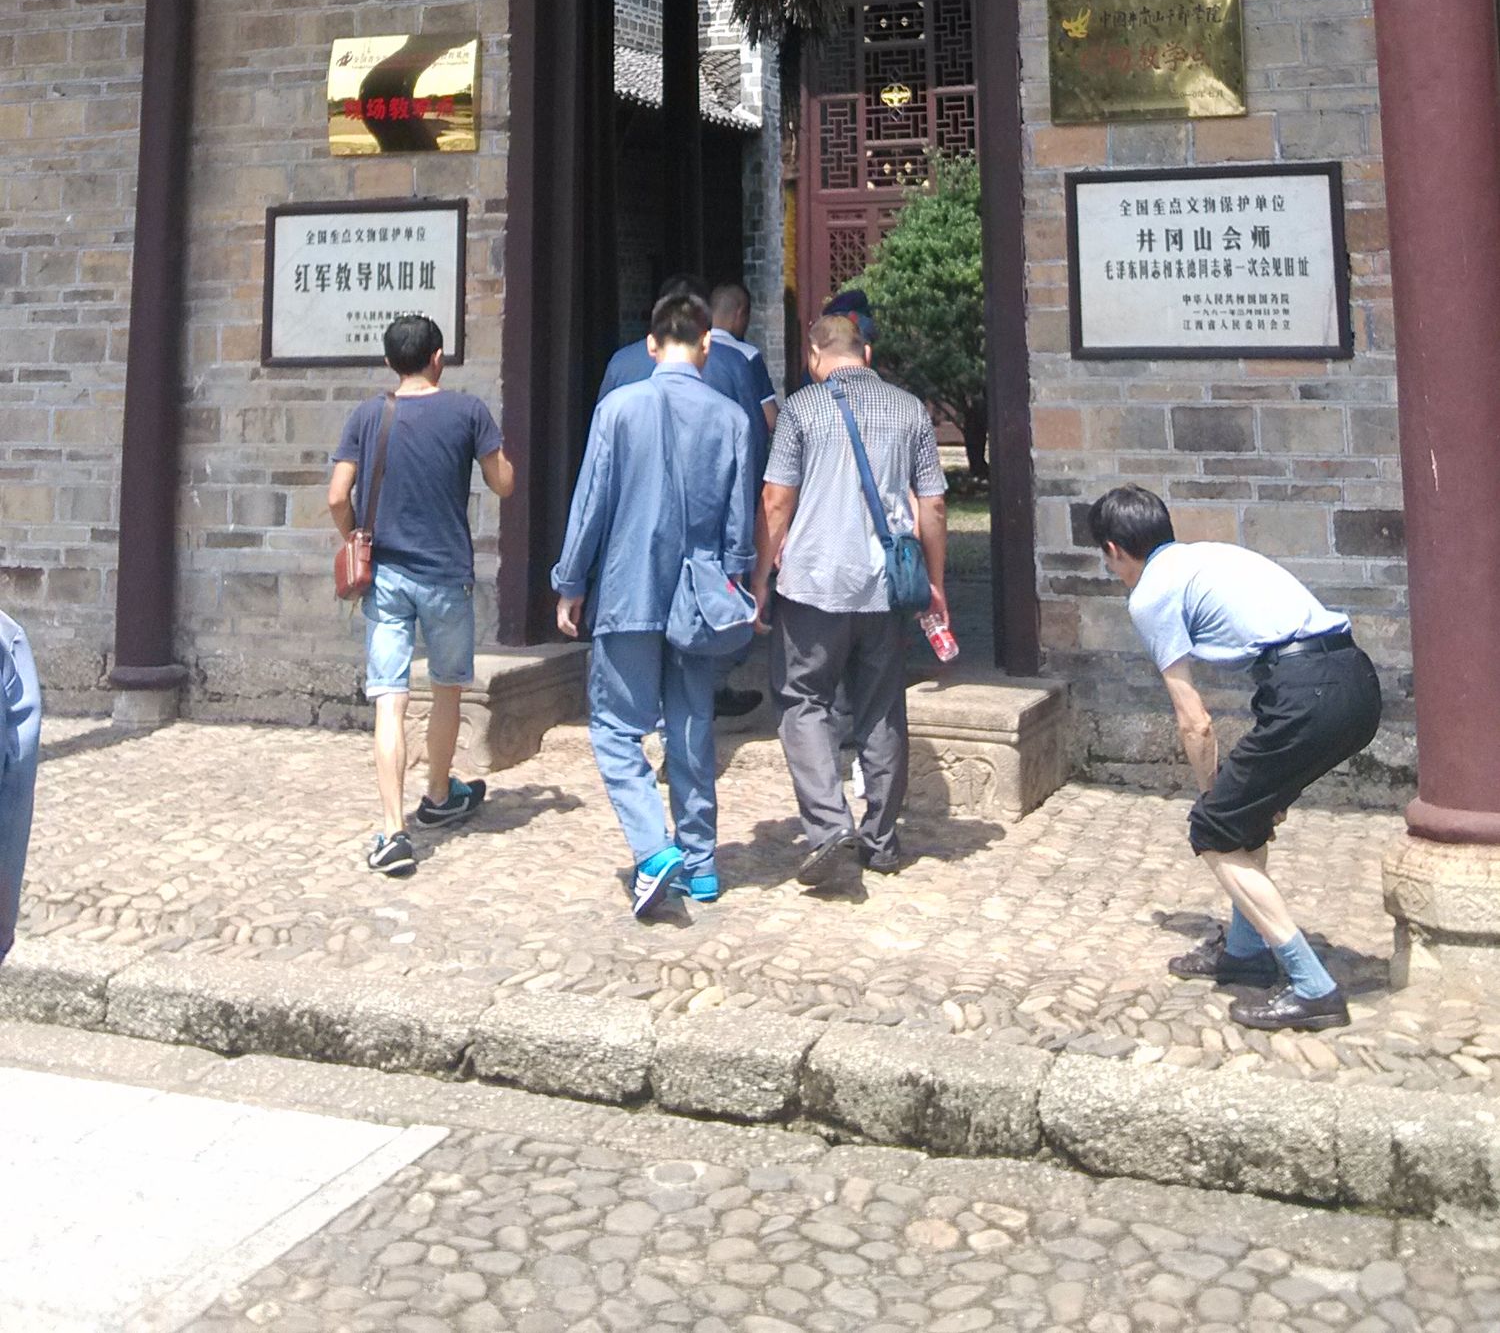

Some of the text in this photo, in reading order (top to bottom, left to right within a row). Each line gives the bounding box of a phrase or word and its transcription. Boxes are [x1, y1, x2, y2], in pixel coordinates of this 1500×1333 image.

[1119, 195, 1286, 216] 全国重点文物保护单位
[306, 226, 426, 245] 全国重点文物保护单位
[1136, 225, 1272, 253] 井冈山会师
[294, 260, 437, 292] 红军教导队旧址
[1104, 256, 1310, 280] 毛泽东同志和朱德同志第一次会见旧址
[1182, 293, 1290, 306] 中华人民共和国国务院
